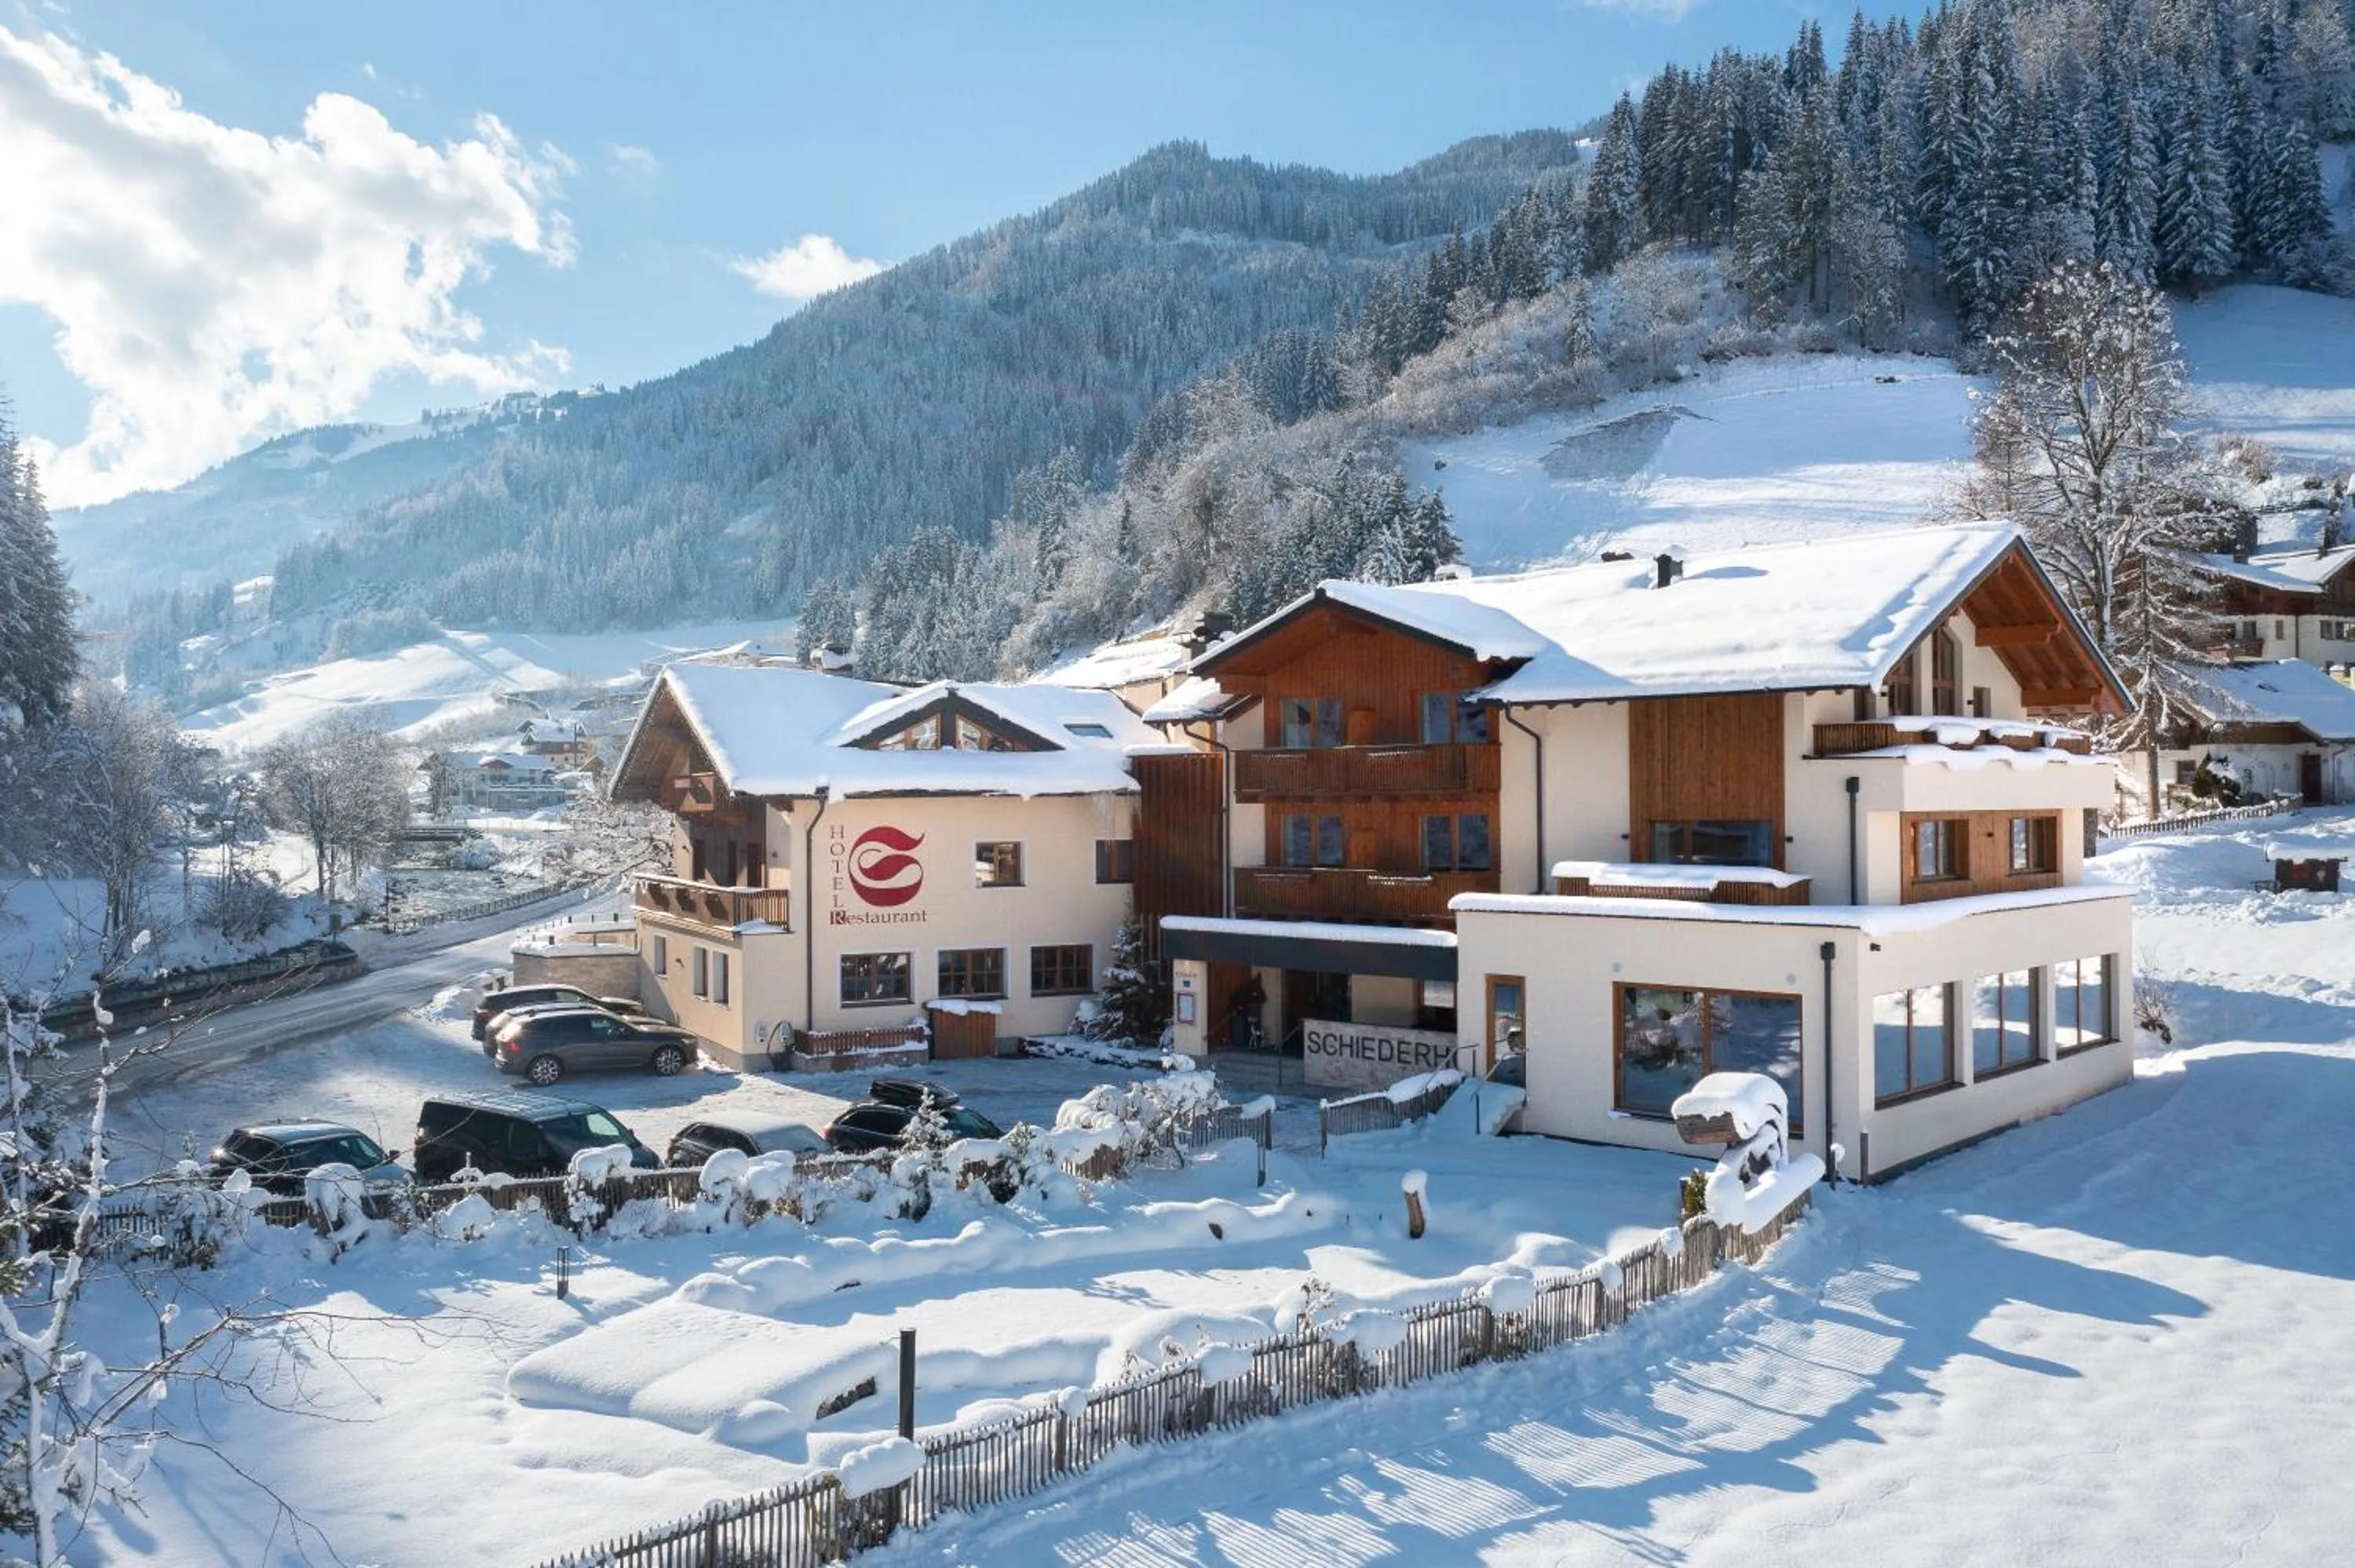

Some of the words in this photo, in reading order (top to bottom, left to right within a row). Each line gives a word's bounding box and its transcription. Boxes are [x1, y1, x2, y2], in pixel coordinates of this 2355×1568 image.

[830, 825, 845, 908] HOTEL
[830, 910, 927, 924] Restaurant
[1307, 1030, 1459, 1070] SCHIEDERH
